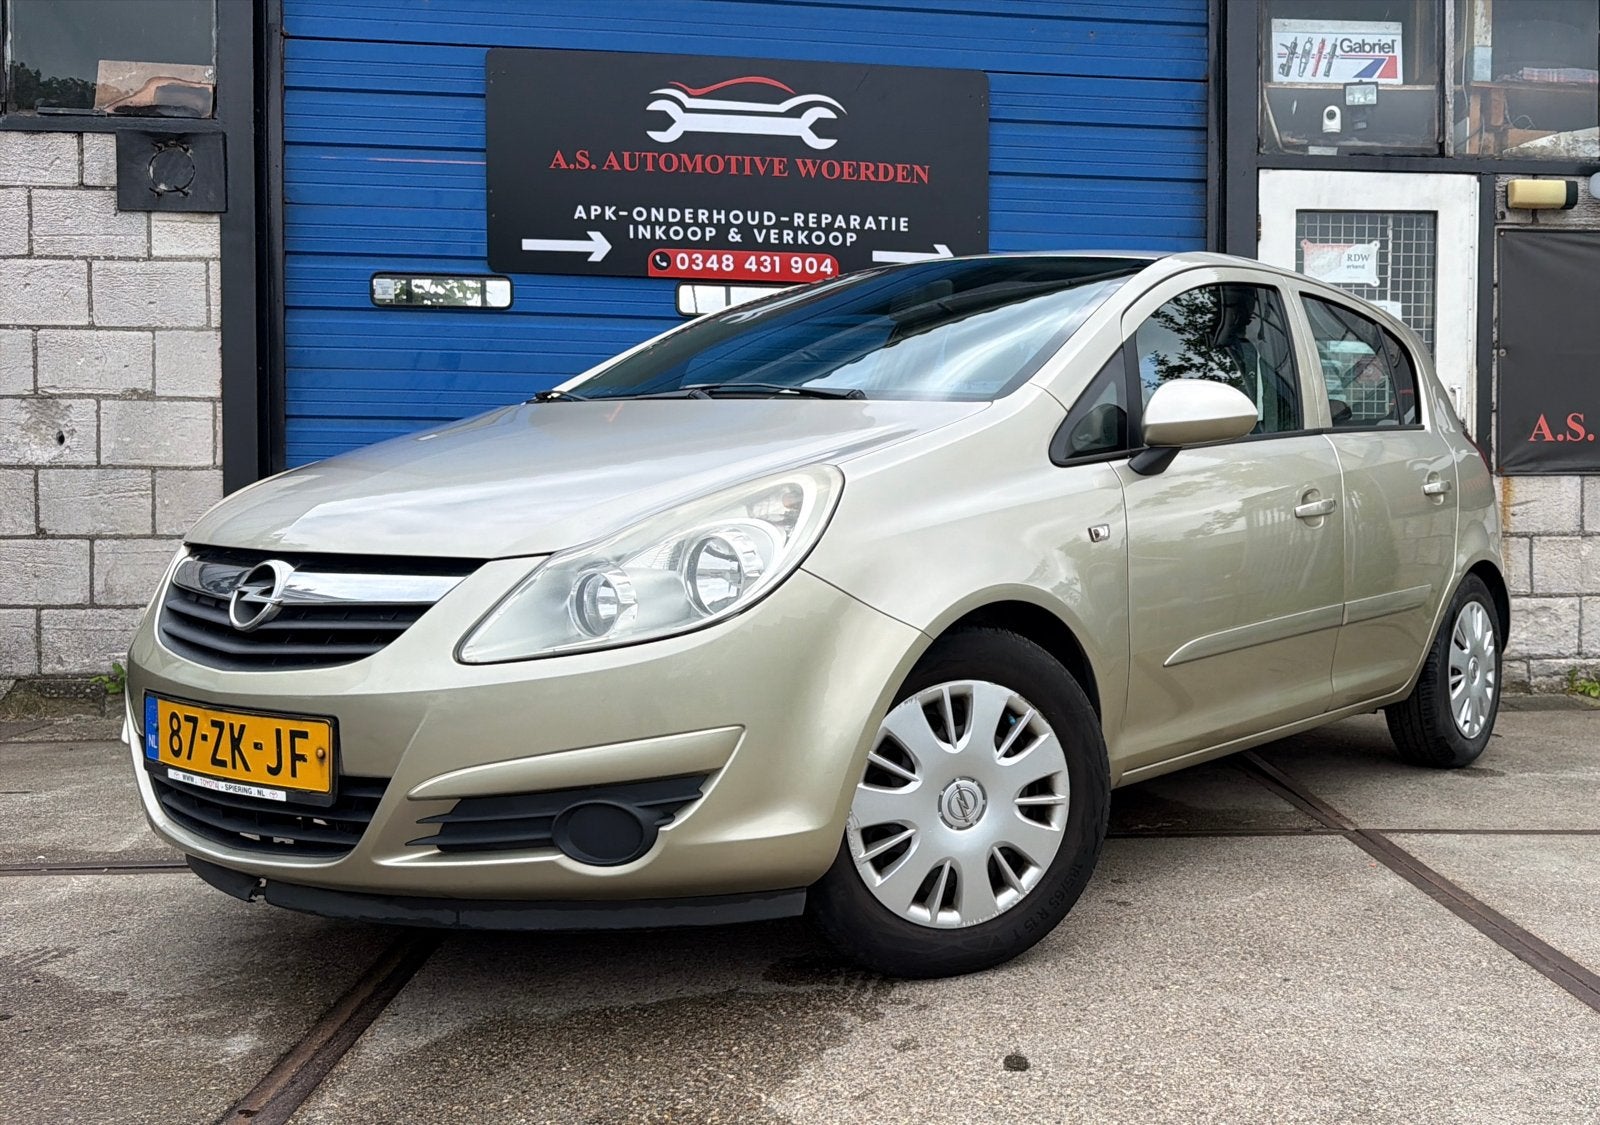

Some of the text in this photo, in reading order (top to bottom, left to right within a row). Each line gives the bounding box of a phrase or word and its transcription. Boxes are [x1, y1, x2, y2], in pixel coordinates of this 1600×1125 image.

[1340, 38, 1396, 54] Gabriel
[550, 150, 930, 184] A.S. AUTOMOTIVE WOERDEN
[573, 204, 909, 232] APK-ONDERHOUD-REPARATIE
[629, 224, 857, 247] INKOOP & VERKOOP
[676, 252, 833, 275] 0348 431 904
[1346, 253, 1370, 262] RDW
[1528, 412, 1595, 442] A.S.
[148, 733, 158, 749] NL
[168, 711, 309, 778] 87-ZK-JF
